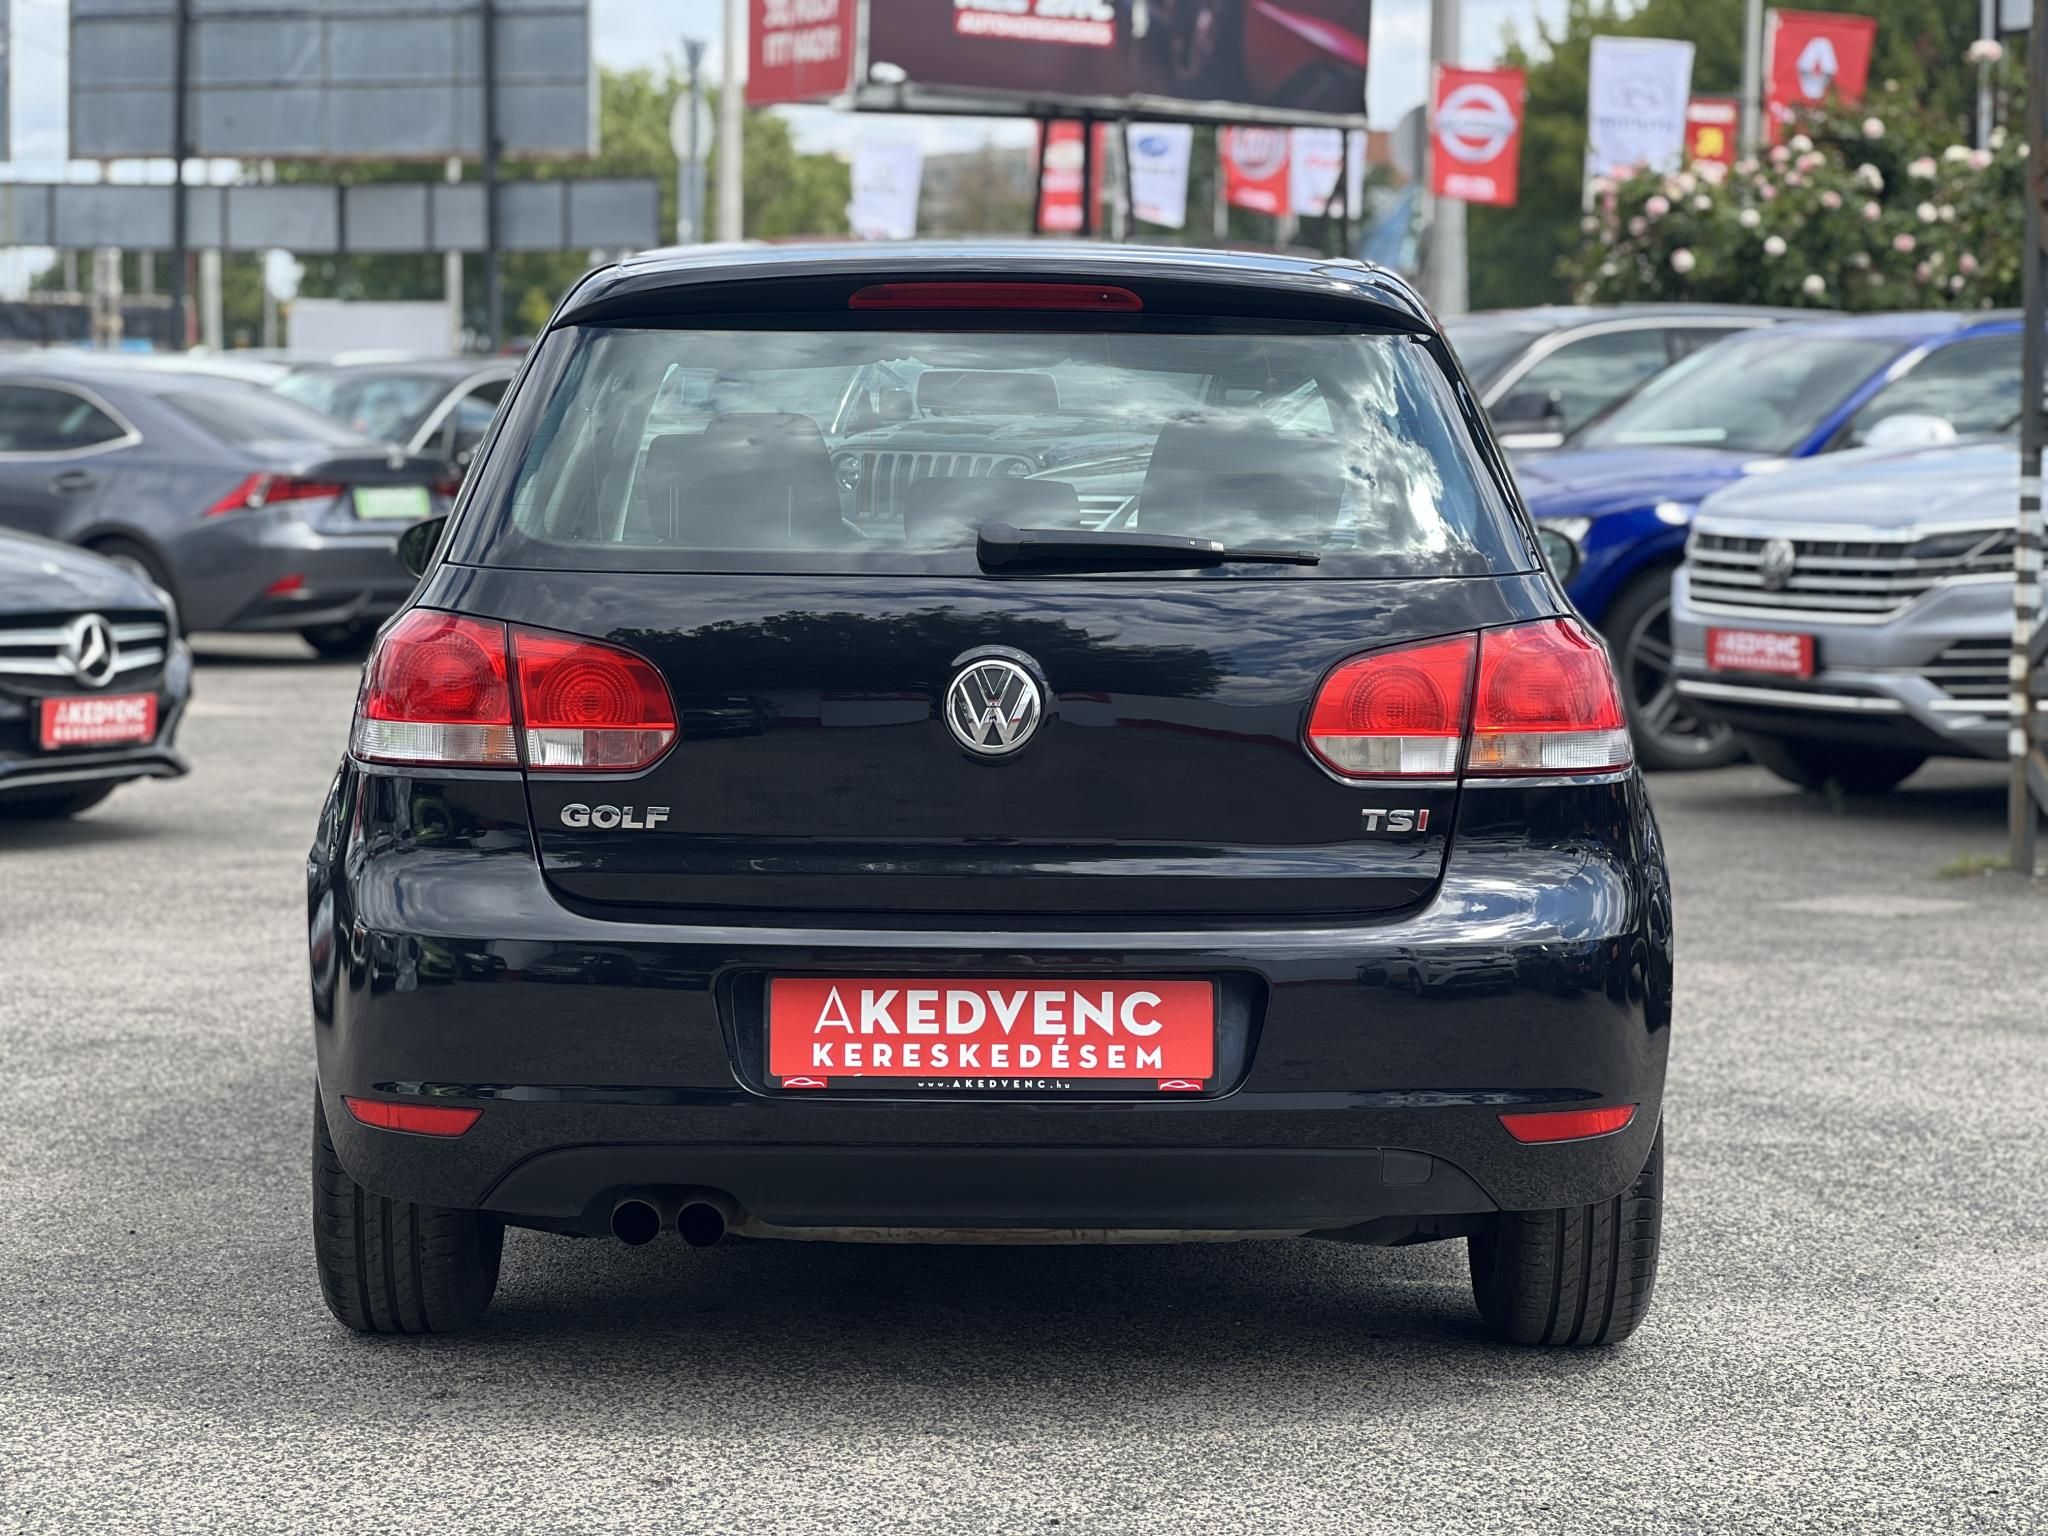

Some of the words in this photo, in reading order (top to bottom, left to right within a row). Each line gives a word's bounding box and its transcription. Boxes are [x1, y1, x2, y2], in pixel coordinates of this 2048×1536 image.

[560, 803, 671, 829] GOLF
[1361, 808, 1430, 832] TSI
[812, 985, 1163, 1036] AKEDVENC
[812, 1037, 1163, 1070] KERESKEDÉSEM
[917, 1079, 1071, 1090] www.AKEDVENC.hu
